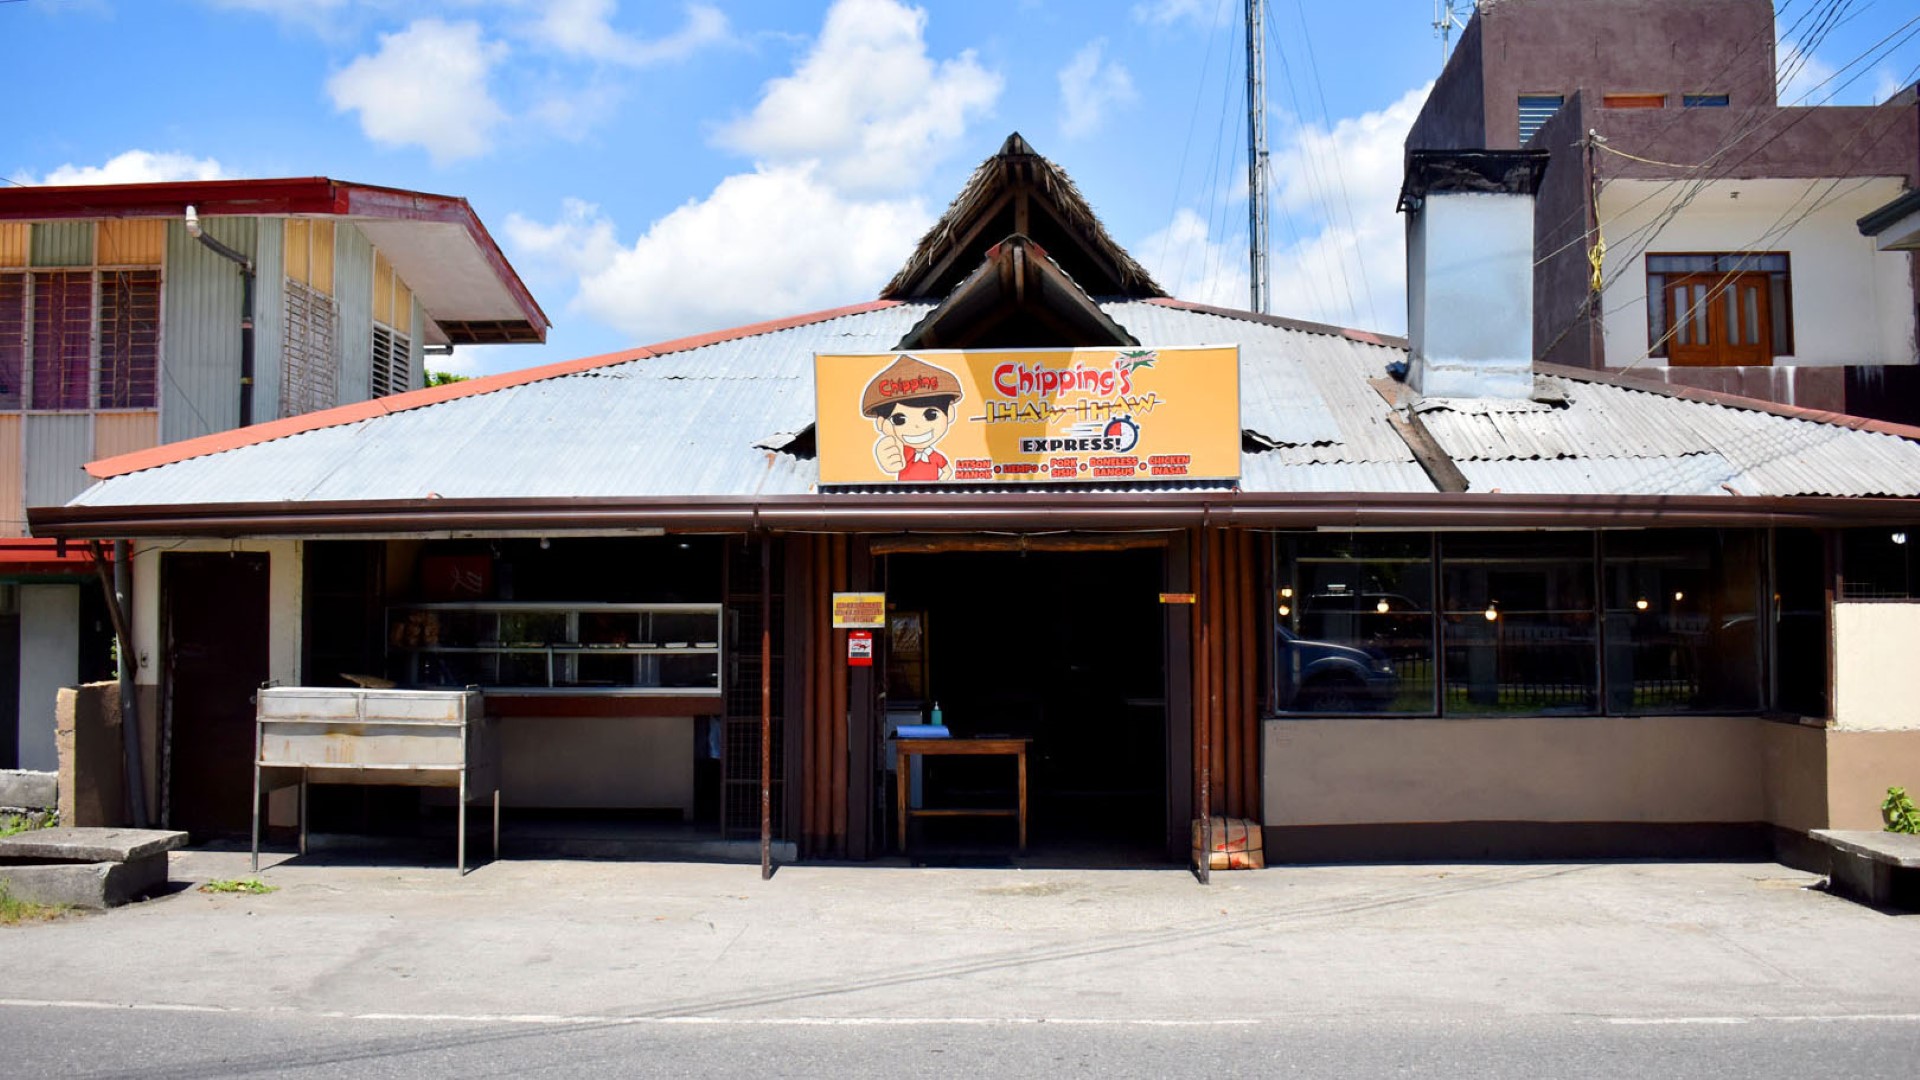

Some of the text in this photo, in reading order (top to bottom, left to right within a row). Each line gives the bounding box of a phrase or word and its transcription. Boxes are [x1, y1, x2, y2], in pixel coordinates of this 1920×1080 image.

[993, 362, 1131, 397] Chipping's
[879, 375, 938, 397] Chipping
[985, 393, 1156, 424] IHAW-IHAW
[1022, 438, 1121, 453] EXPRESS!
[1050, 458, 1077, 468] PORK
[1089, 456, 1138, 467] BONELESS
[1148, 455, 1190, 465] CHICKEN
[955, 469, 992, 479] MANOK
[1050, 468, 1077, 477] SISIG
[1094, 467, 1134, 477] BANGUS
[1151, 465, 1187, 475] INASAL
